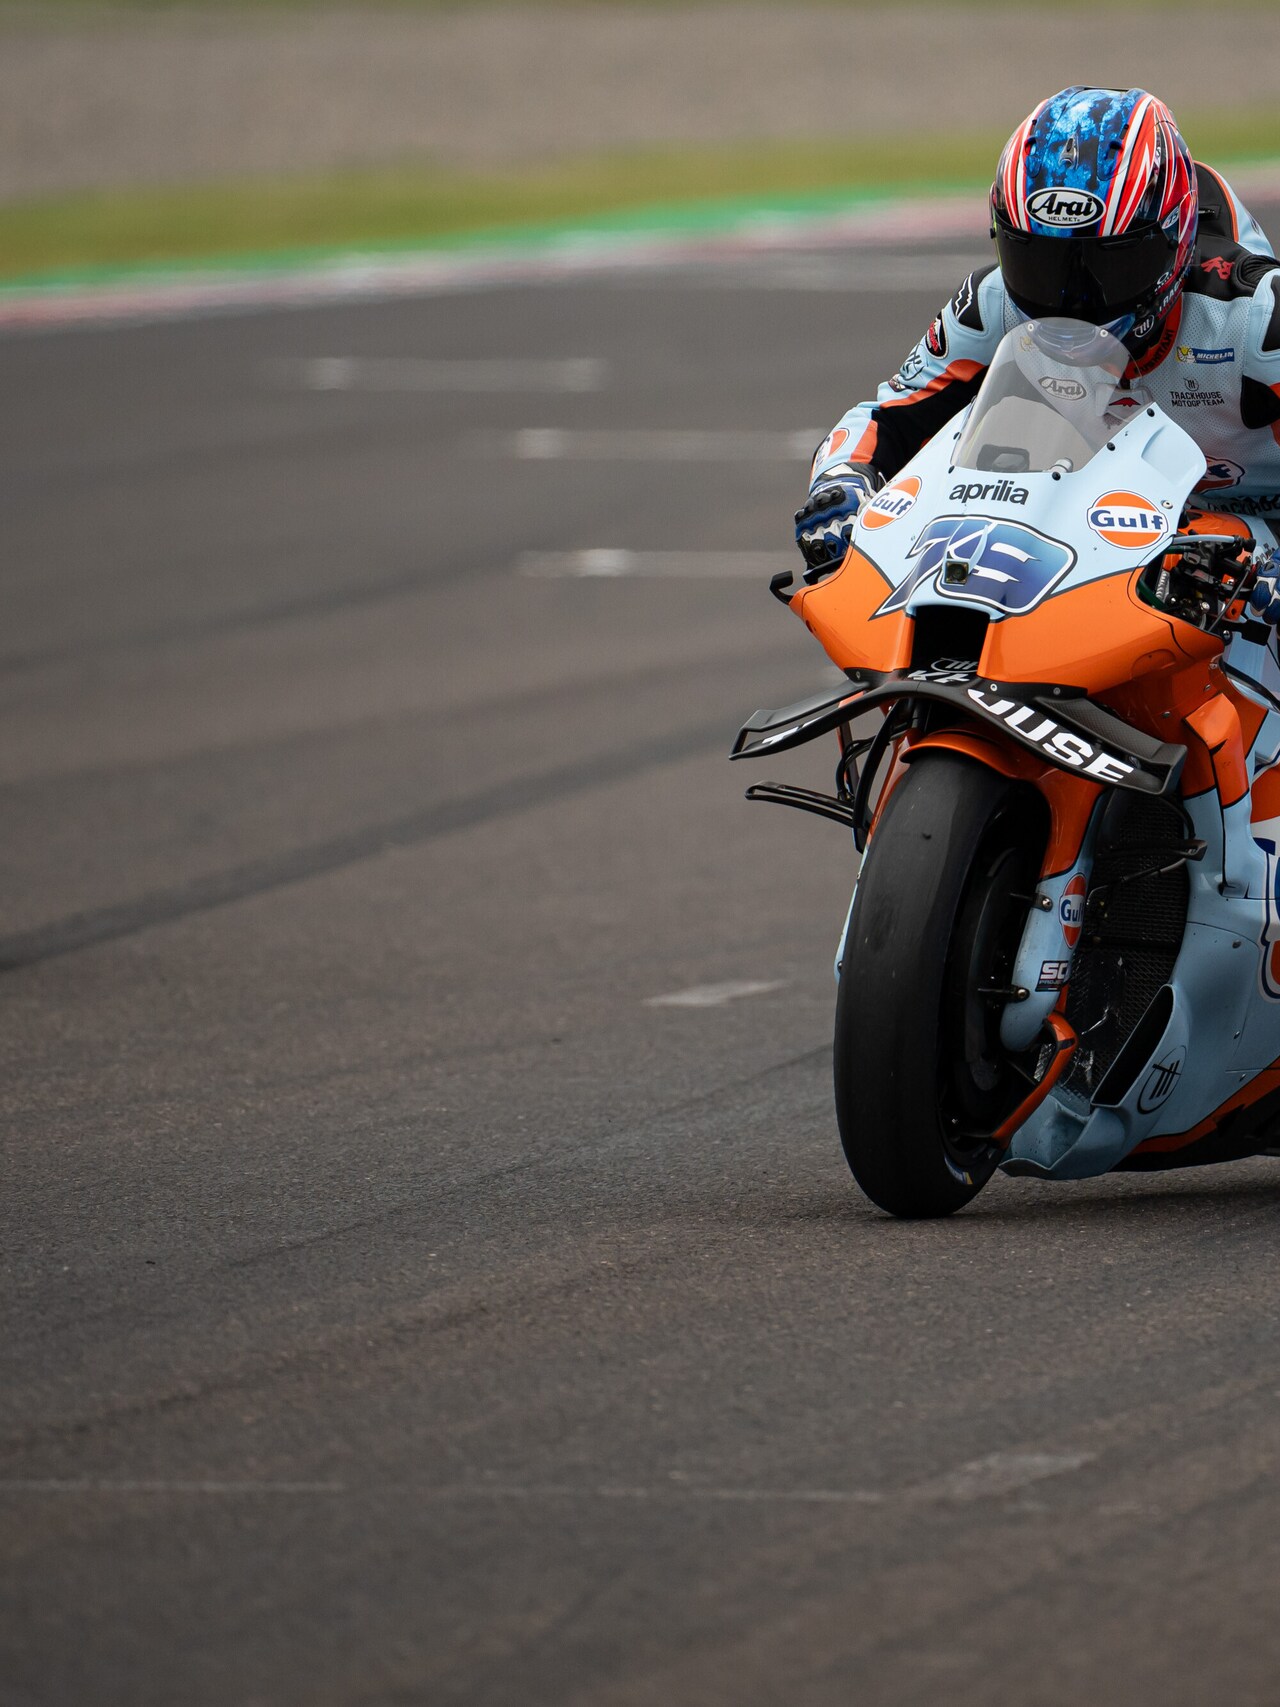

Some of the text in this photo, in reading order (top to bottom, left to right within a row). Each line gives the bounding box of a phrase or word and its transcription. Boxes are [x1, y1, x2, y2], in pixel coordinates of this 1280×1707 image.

[1031, 193, 1094, 216] Arai
[1196, 351, 1234, 359] MICHELIN
[1043, 379, 1083, 396] Arai
[1170, 391, 1222, 400] TRACKHOUSE
[1202, 399, 1225, 407] TEAM
[948, 479, 1029, 505] aprilia
[871, 492, 913, 516] Gulf
[1090, 510, 1163, 529] Gulf
